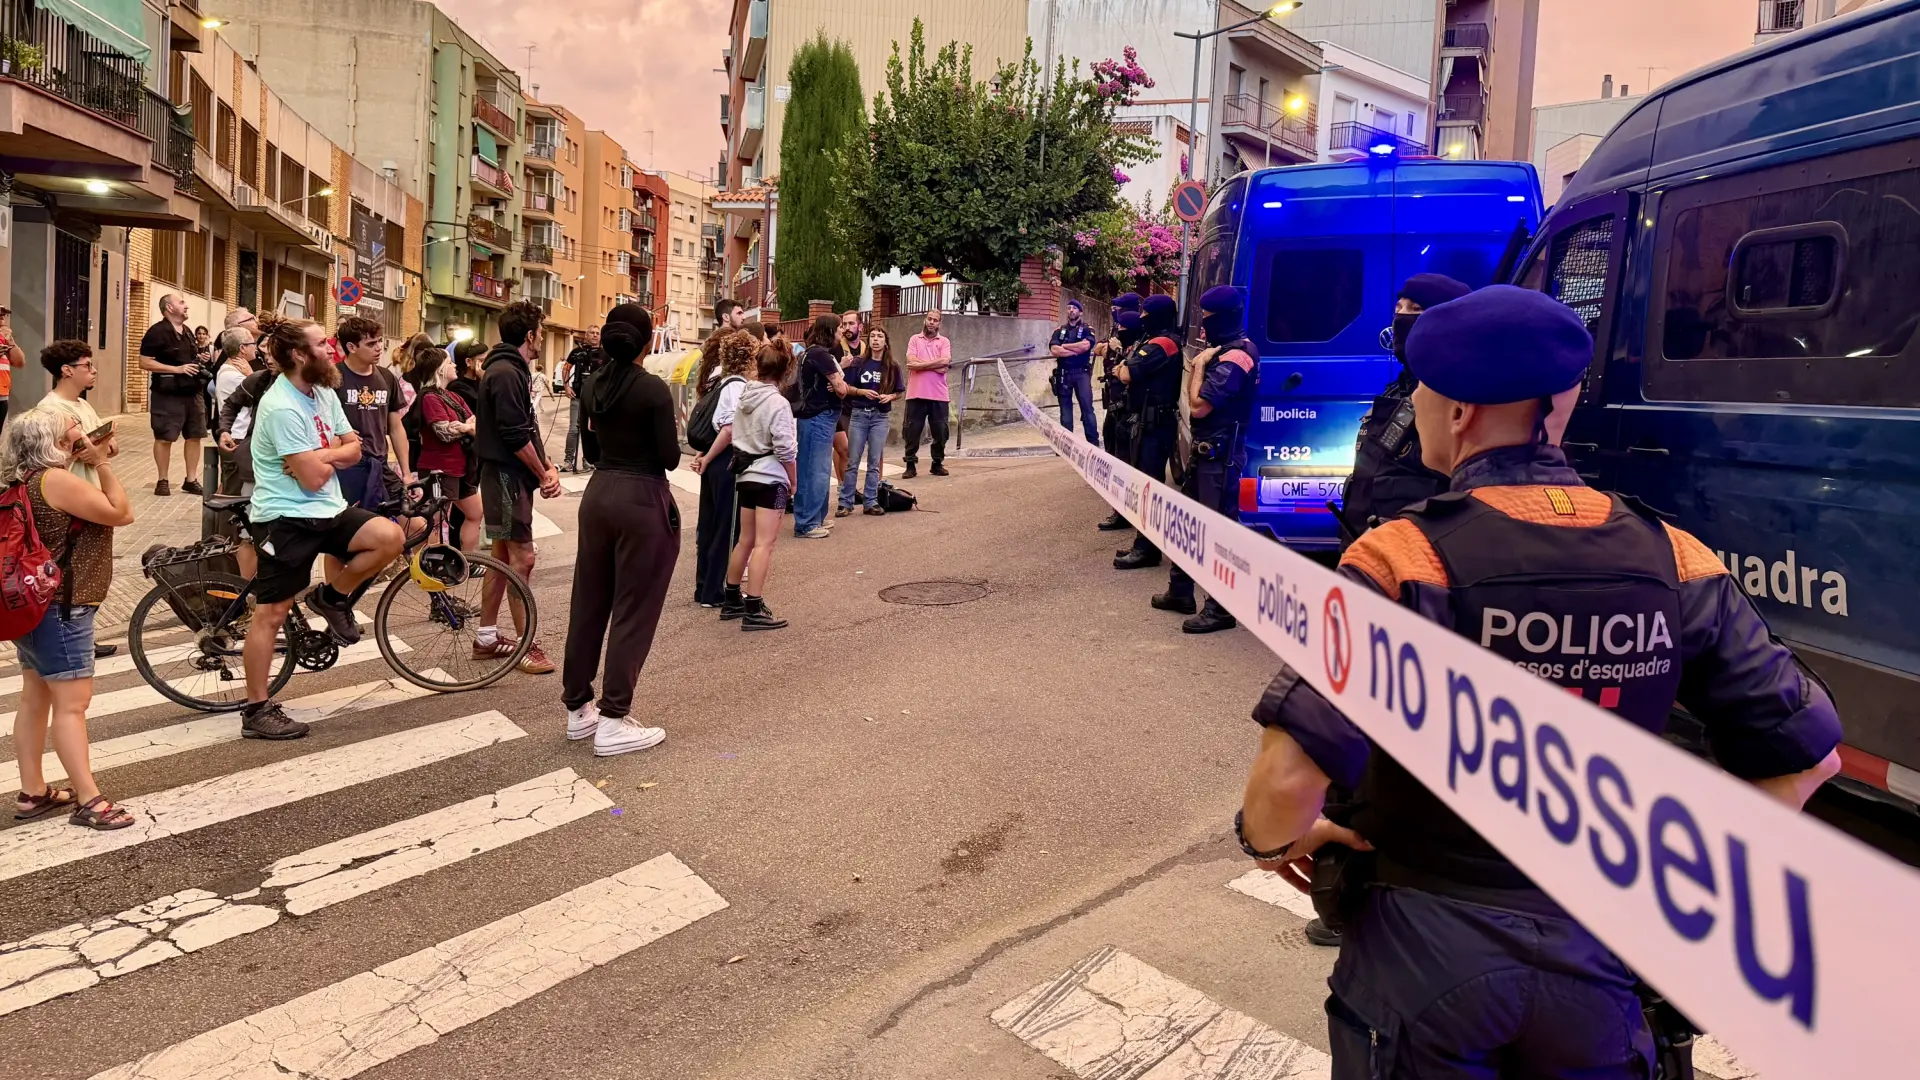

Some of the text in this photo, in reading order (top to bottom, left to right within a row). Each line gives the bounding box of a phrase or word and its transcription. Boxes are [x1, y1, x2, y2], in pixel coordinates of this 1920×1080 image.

[347, 389, 388, 404] 18 99
[1276, 408, 1317, 421] policia
[1263, 445, 1312, 461] T-832
[1281, 482, 1310, 497] CME
[1150, 492, 1207, 567] no passeu
[1258, 573, 1308, 648] policia
[1480, 606, 1674, 656] POLICIA
[1569, 655, 1671, 683] d'esquadra
[1368, 621, 1818, 1034] no passeu
